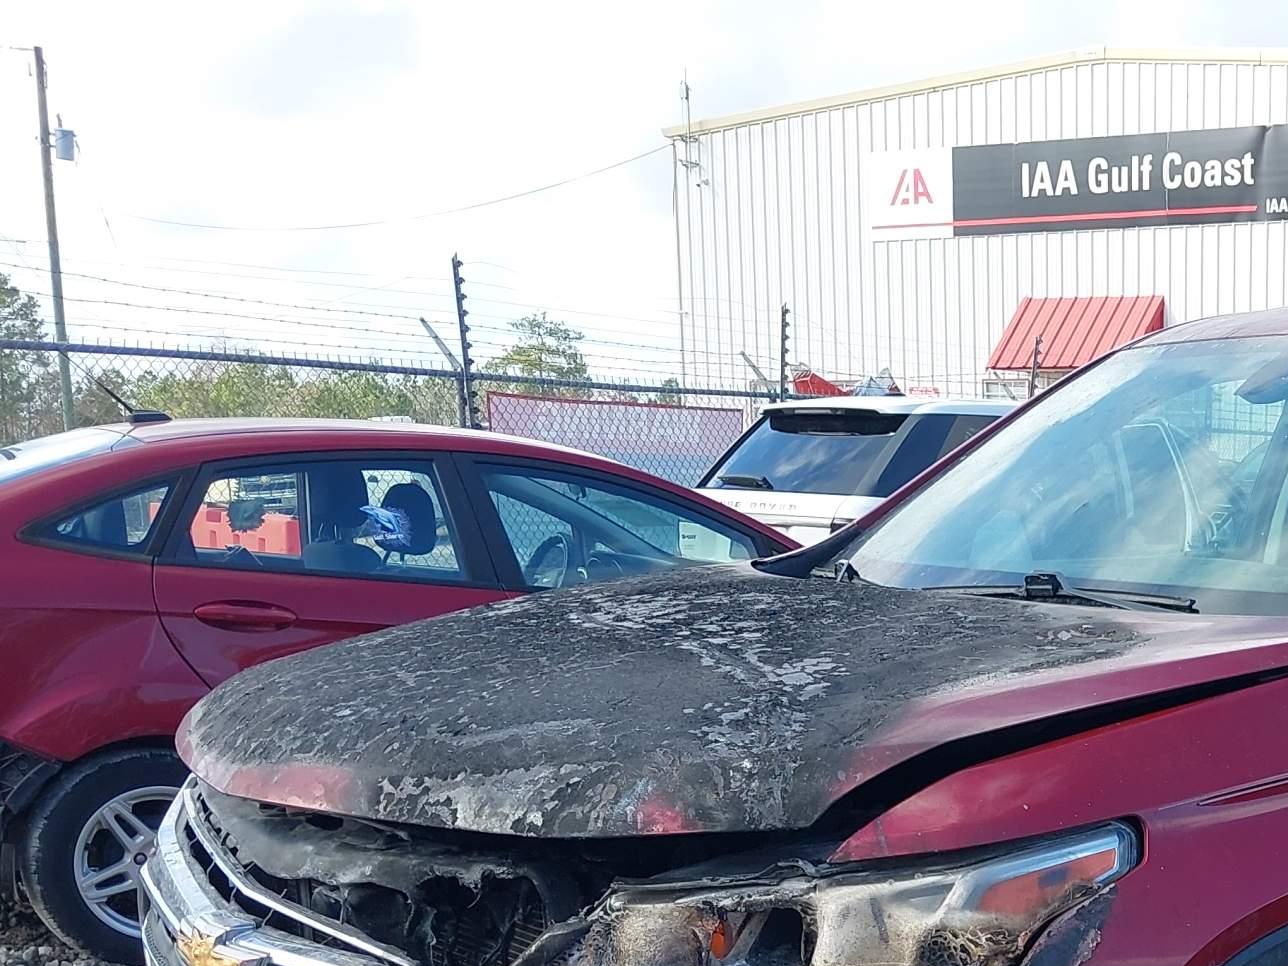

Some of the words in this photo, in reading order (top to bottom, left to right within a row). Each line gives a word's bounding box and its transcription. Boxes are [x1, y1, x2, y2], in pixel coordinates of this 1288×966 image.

[1020, 159, 1078, 198] IAA
[1087, 153, 1154, 194] Gulf
[1161, 151, 1255, 190] Coast
